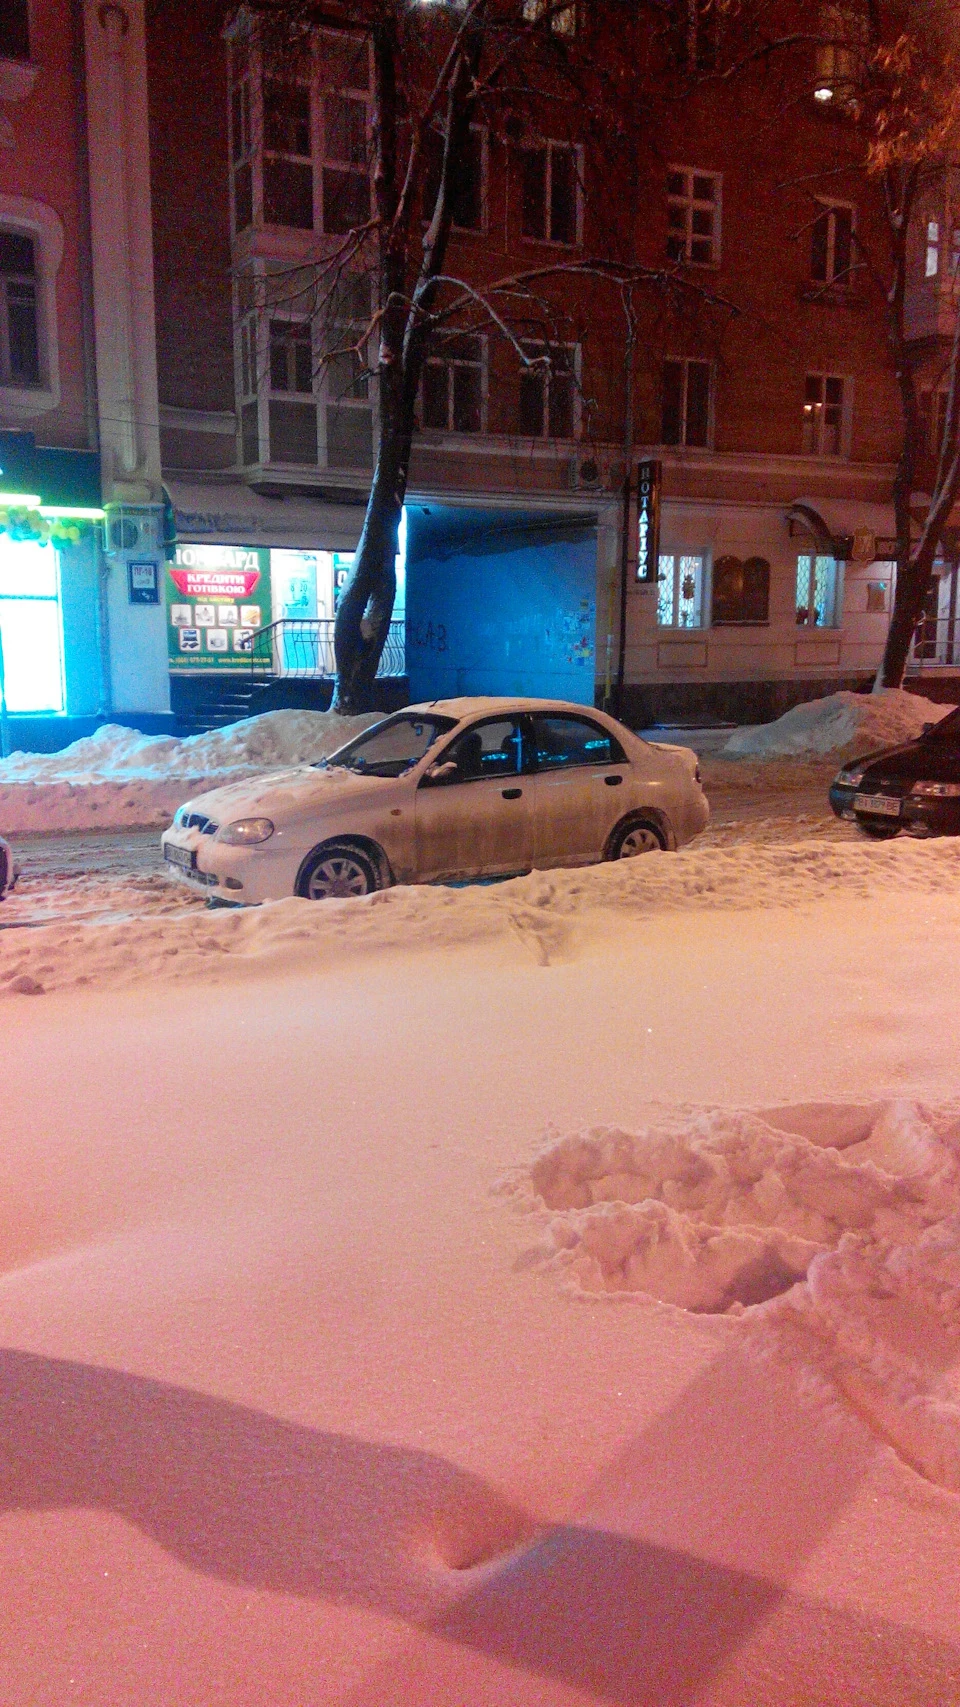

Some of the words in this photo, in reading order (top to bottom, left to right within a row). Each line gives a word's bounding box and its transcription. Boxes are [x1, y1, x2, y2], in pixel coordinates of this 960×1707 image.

[637, 468, 650, 579] НОТАРІУС
[169, 549, 260, 571] ЛОМАРД
[187, 573, 245, 584] КРЕДИТИ
[187, 585, 246, 594] ГОТІВКОЮ
